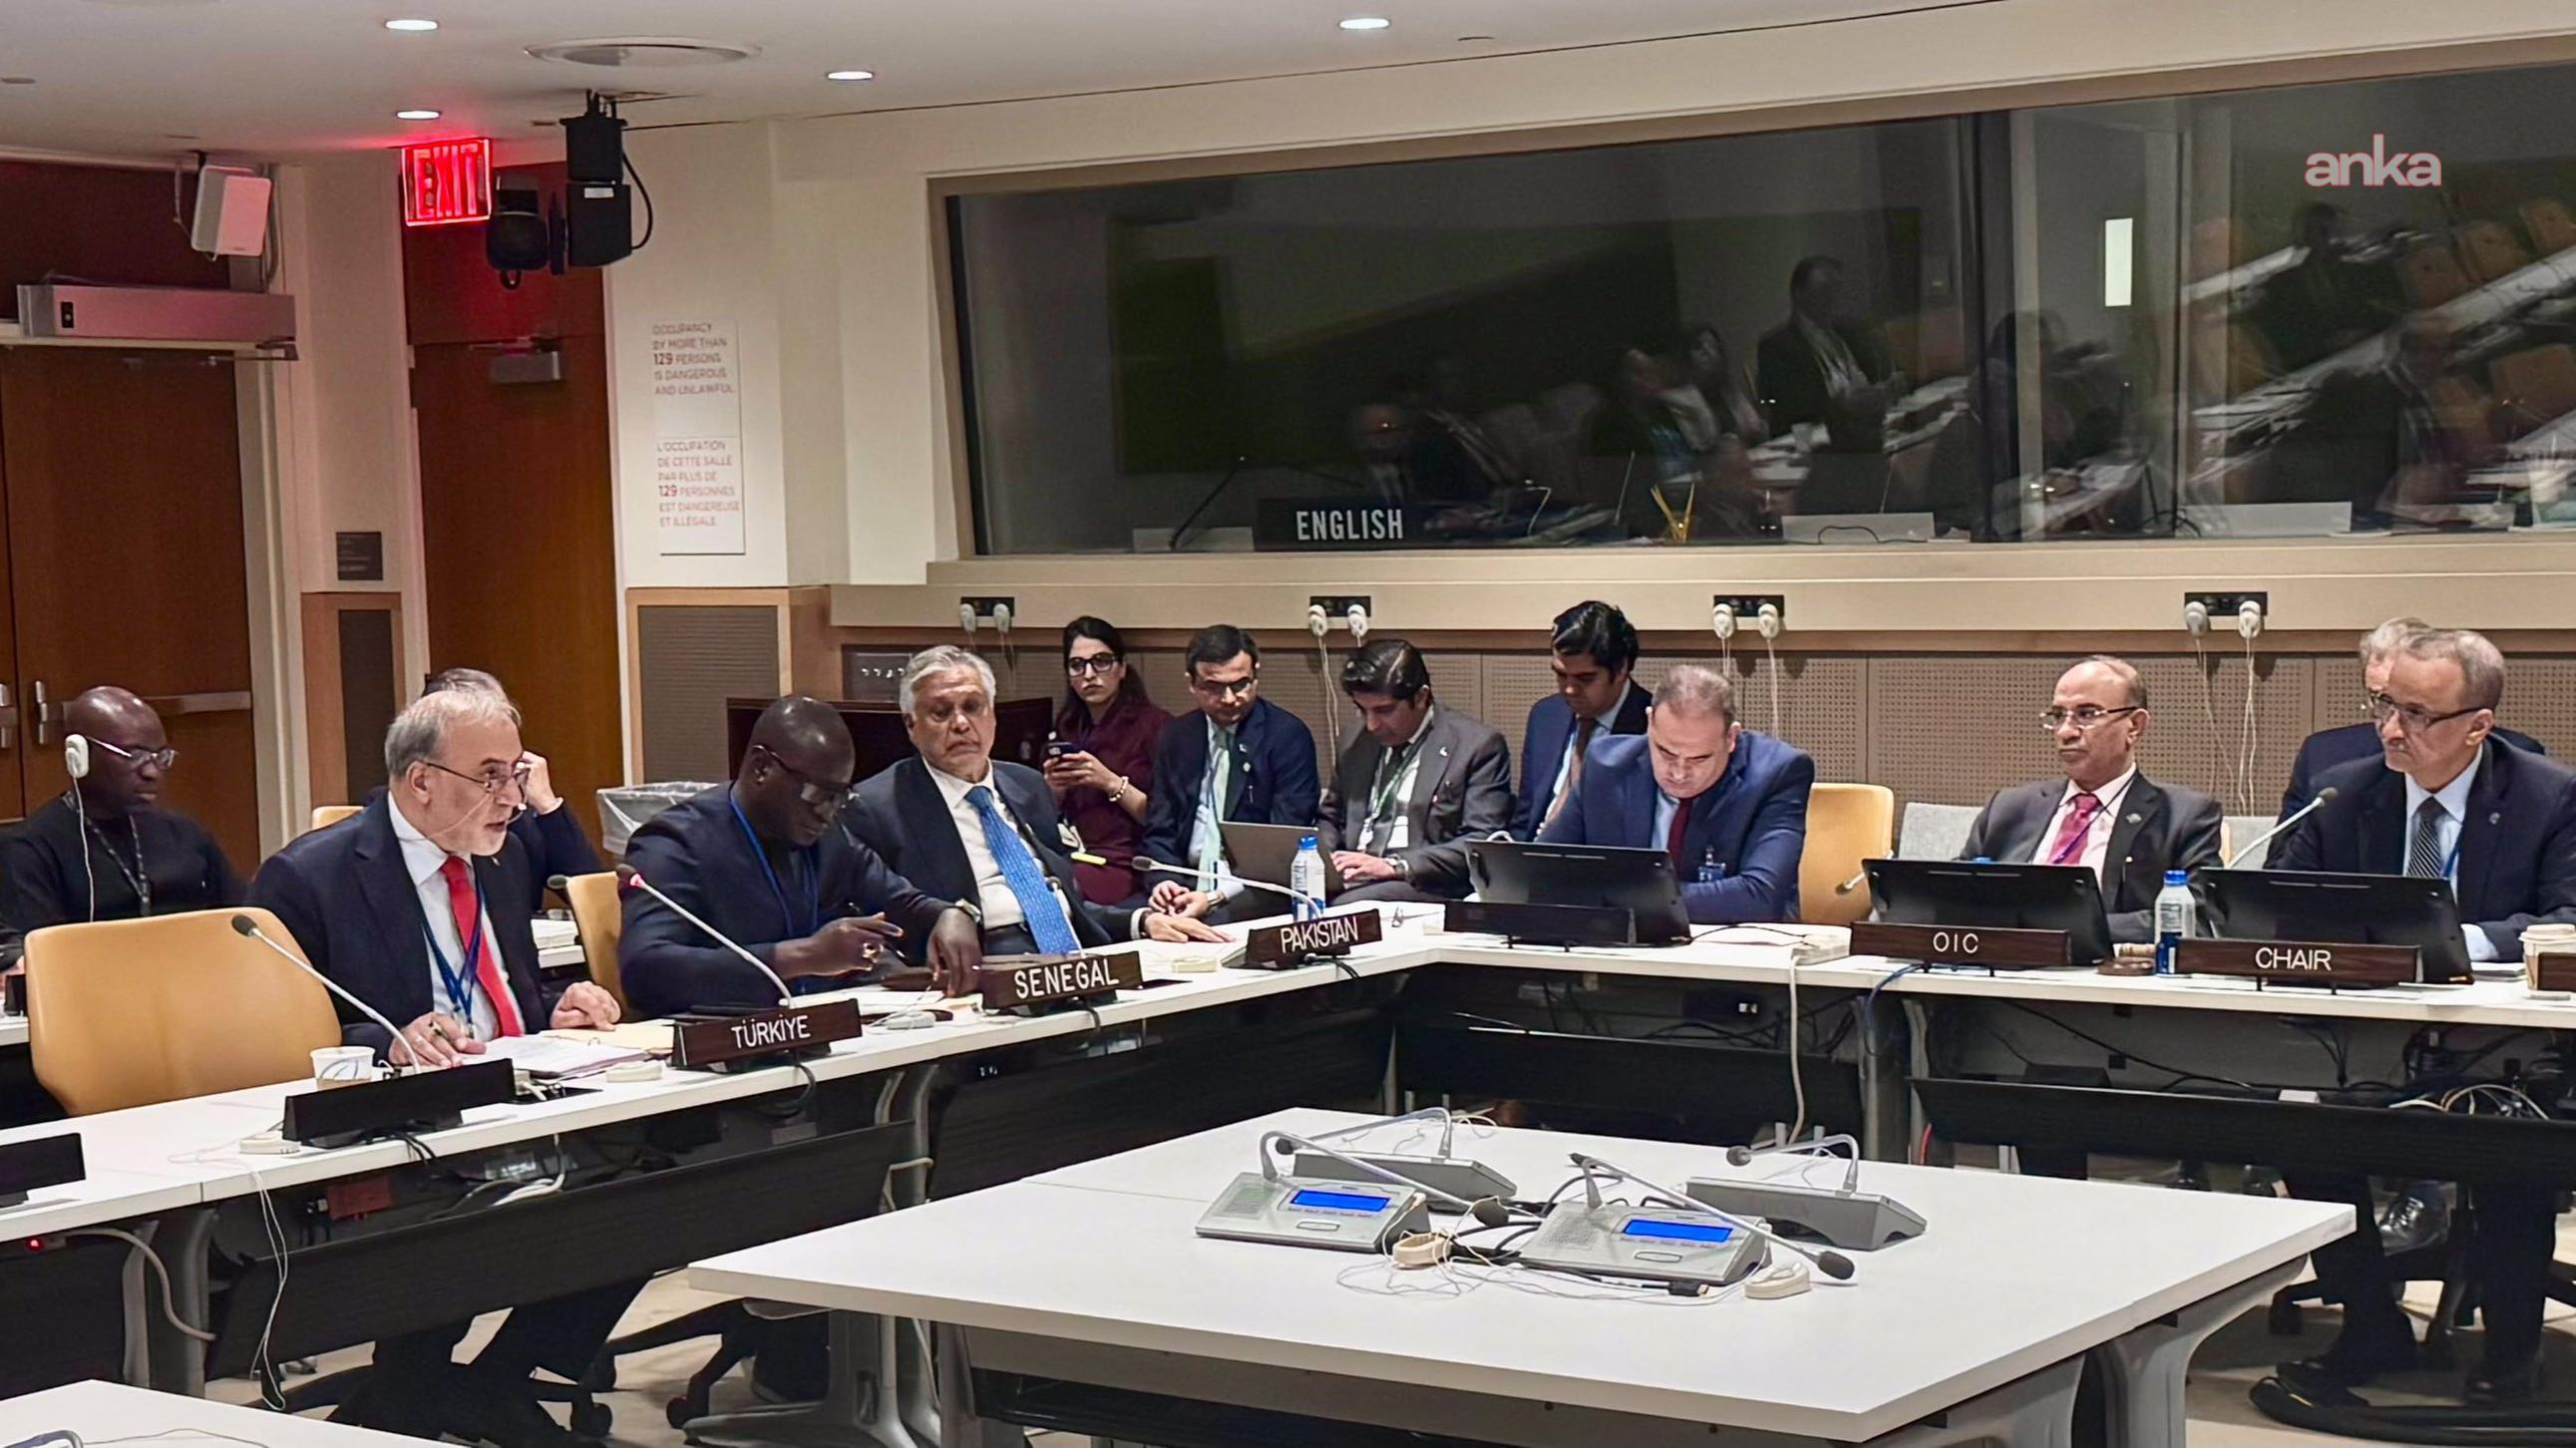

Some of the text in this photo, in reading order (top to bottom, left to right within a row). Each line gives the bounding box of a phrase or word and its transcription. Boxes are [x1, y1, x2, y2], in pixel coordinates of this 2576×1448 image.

[413, 143, 479, 219] EXIT
[652, 323, 712, 335] OCCUPANCY
[653, 337, 728, 350] BY MORE THAN
[653, 352, 722, 366] 129 PERSONS
[653, 367, 727, 381] IS DANGEROUS
[653, 384, 676, 396] AND
[657, 455, 733, 468] DE CETTE SALLE
[658, 471, 717, 482] PAR PLUS DE
[658, 484, 735, 498] 129 PERSONNES
[659, 501, 740, 513] EST DANGEREUSE
[660, 517, 671, 528] ET
[1296, 509, 1403, 541] ENGLISH
[1281, 916, 1359, 953] PAKISTAN
[1933, 931, 1979, 954] OIC
[2255, 947, 2332, 971] CHAIR
[1014, 958, 1120, 999] SENEGAL
[731, 1004, 811, 1049] TÜRKİYE
